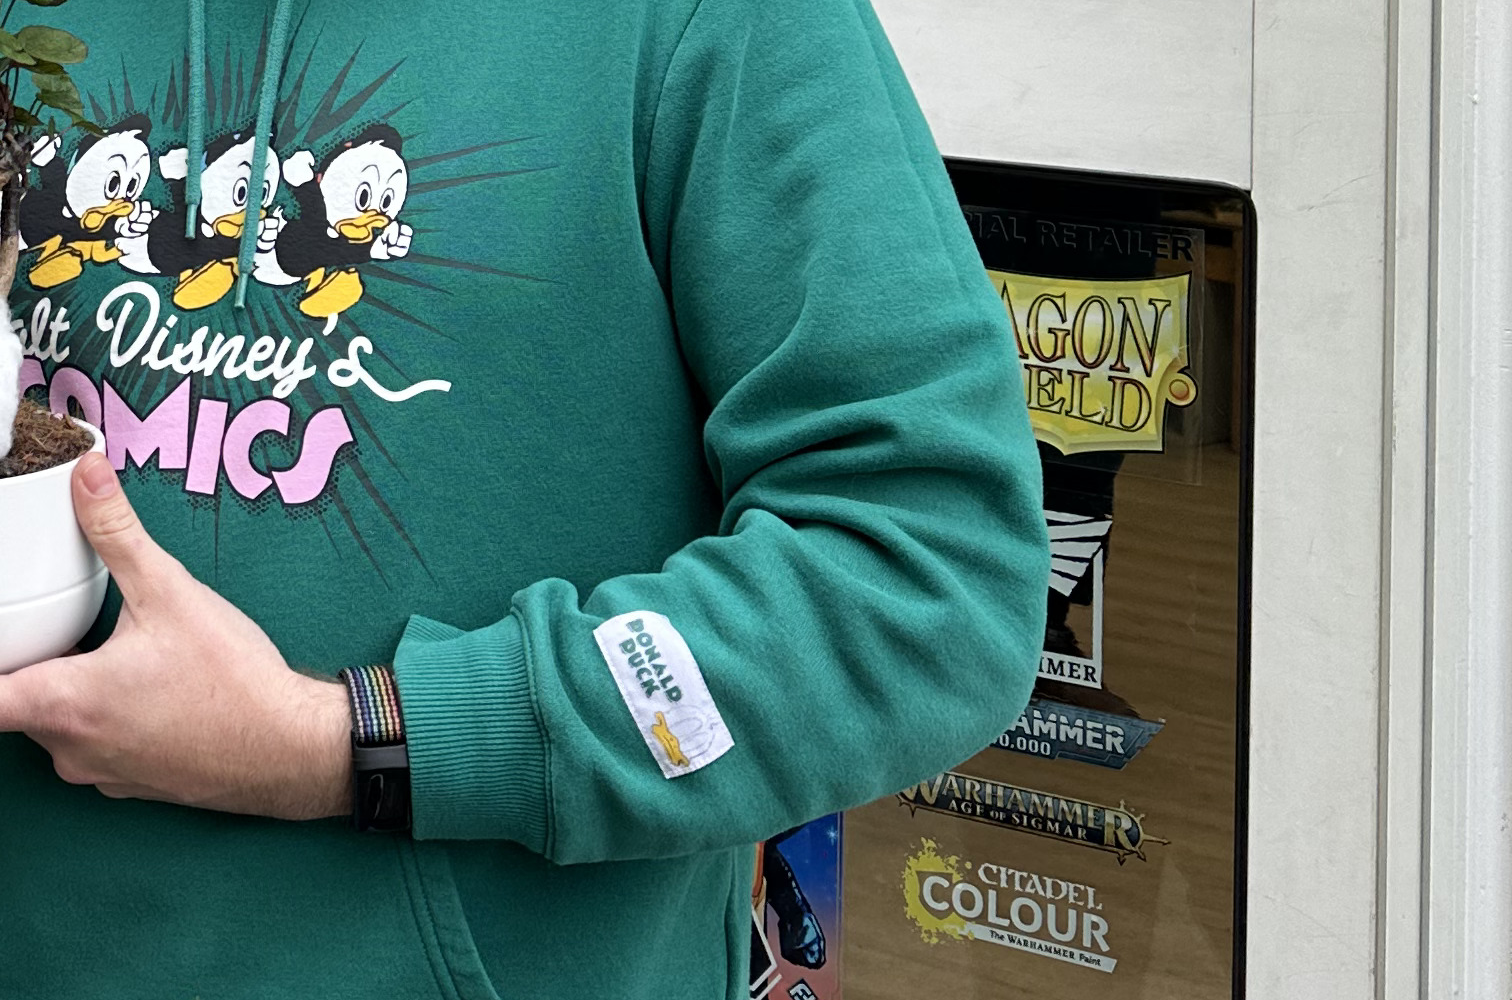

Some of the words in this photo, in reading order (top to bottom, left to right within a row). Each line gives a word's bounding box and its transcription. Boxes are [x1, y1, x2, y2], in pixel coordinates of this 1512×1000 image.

[964, 211, 1027, 244] IAL
[1036, 218, 1193, 262] RETAILER
[96, 281, 452, 402] Disney's
[1024, 363, 1153, 432] ELD
[619, 638, 661, 699] DUCK
[626, 618, 683, 703] DONALD
[993, 733, 1051, 756] 0.000
[900, 773, 1138, 851] WARHAMMER
[949, 799, 985, 816] AGE
[1011, 812, 1088, 840] SIGMAR
[922, 875, 1111, 952] COLOUR
[978, 862, 1103, 910] CITADEL
[989, 929, 1005, 942] The
[1007, 933, 1076, 960] WARHAMMER
[1079, 952, 1102, 966] Paint
